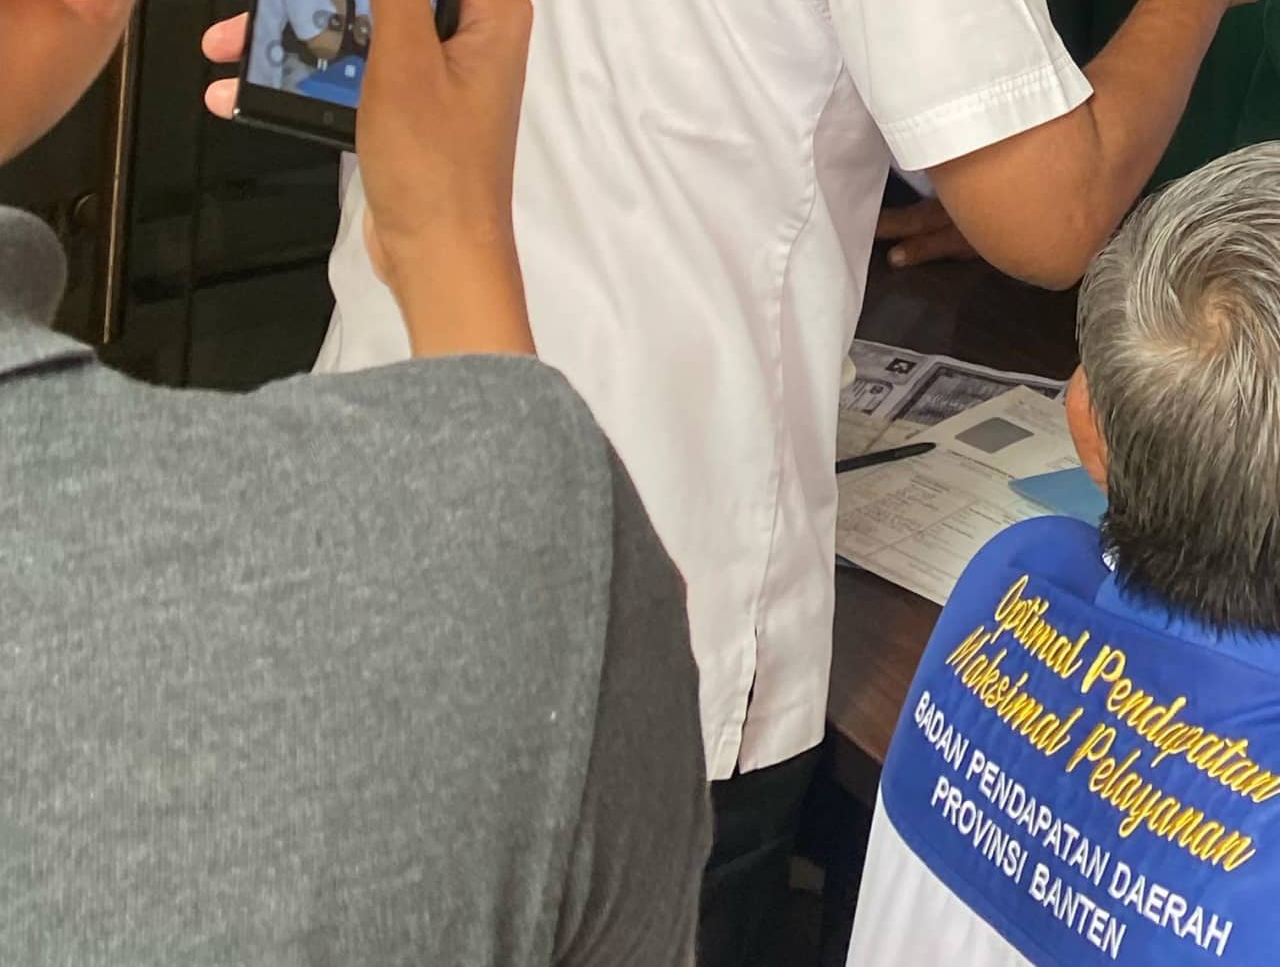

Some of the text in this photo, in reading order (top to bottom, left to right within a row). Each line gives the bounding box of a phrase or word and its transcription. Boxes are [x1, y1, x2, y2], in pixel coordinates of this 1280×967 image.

[993, 574, 1091, 680] Optimal
[913, 690, 1234, 958] BADAN PENDAPATAN DAERAH
[945, 625, 1257, 873] Maksimal Pelayanan
[930, 776, 1128, 960] PROVINSI BANTEN
